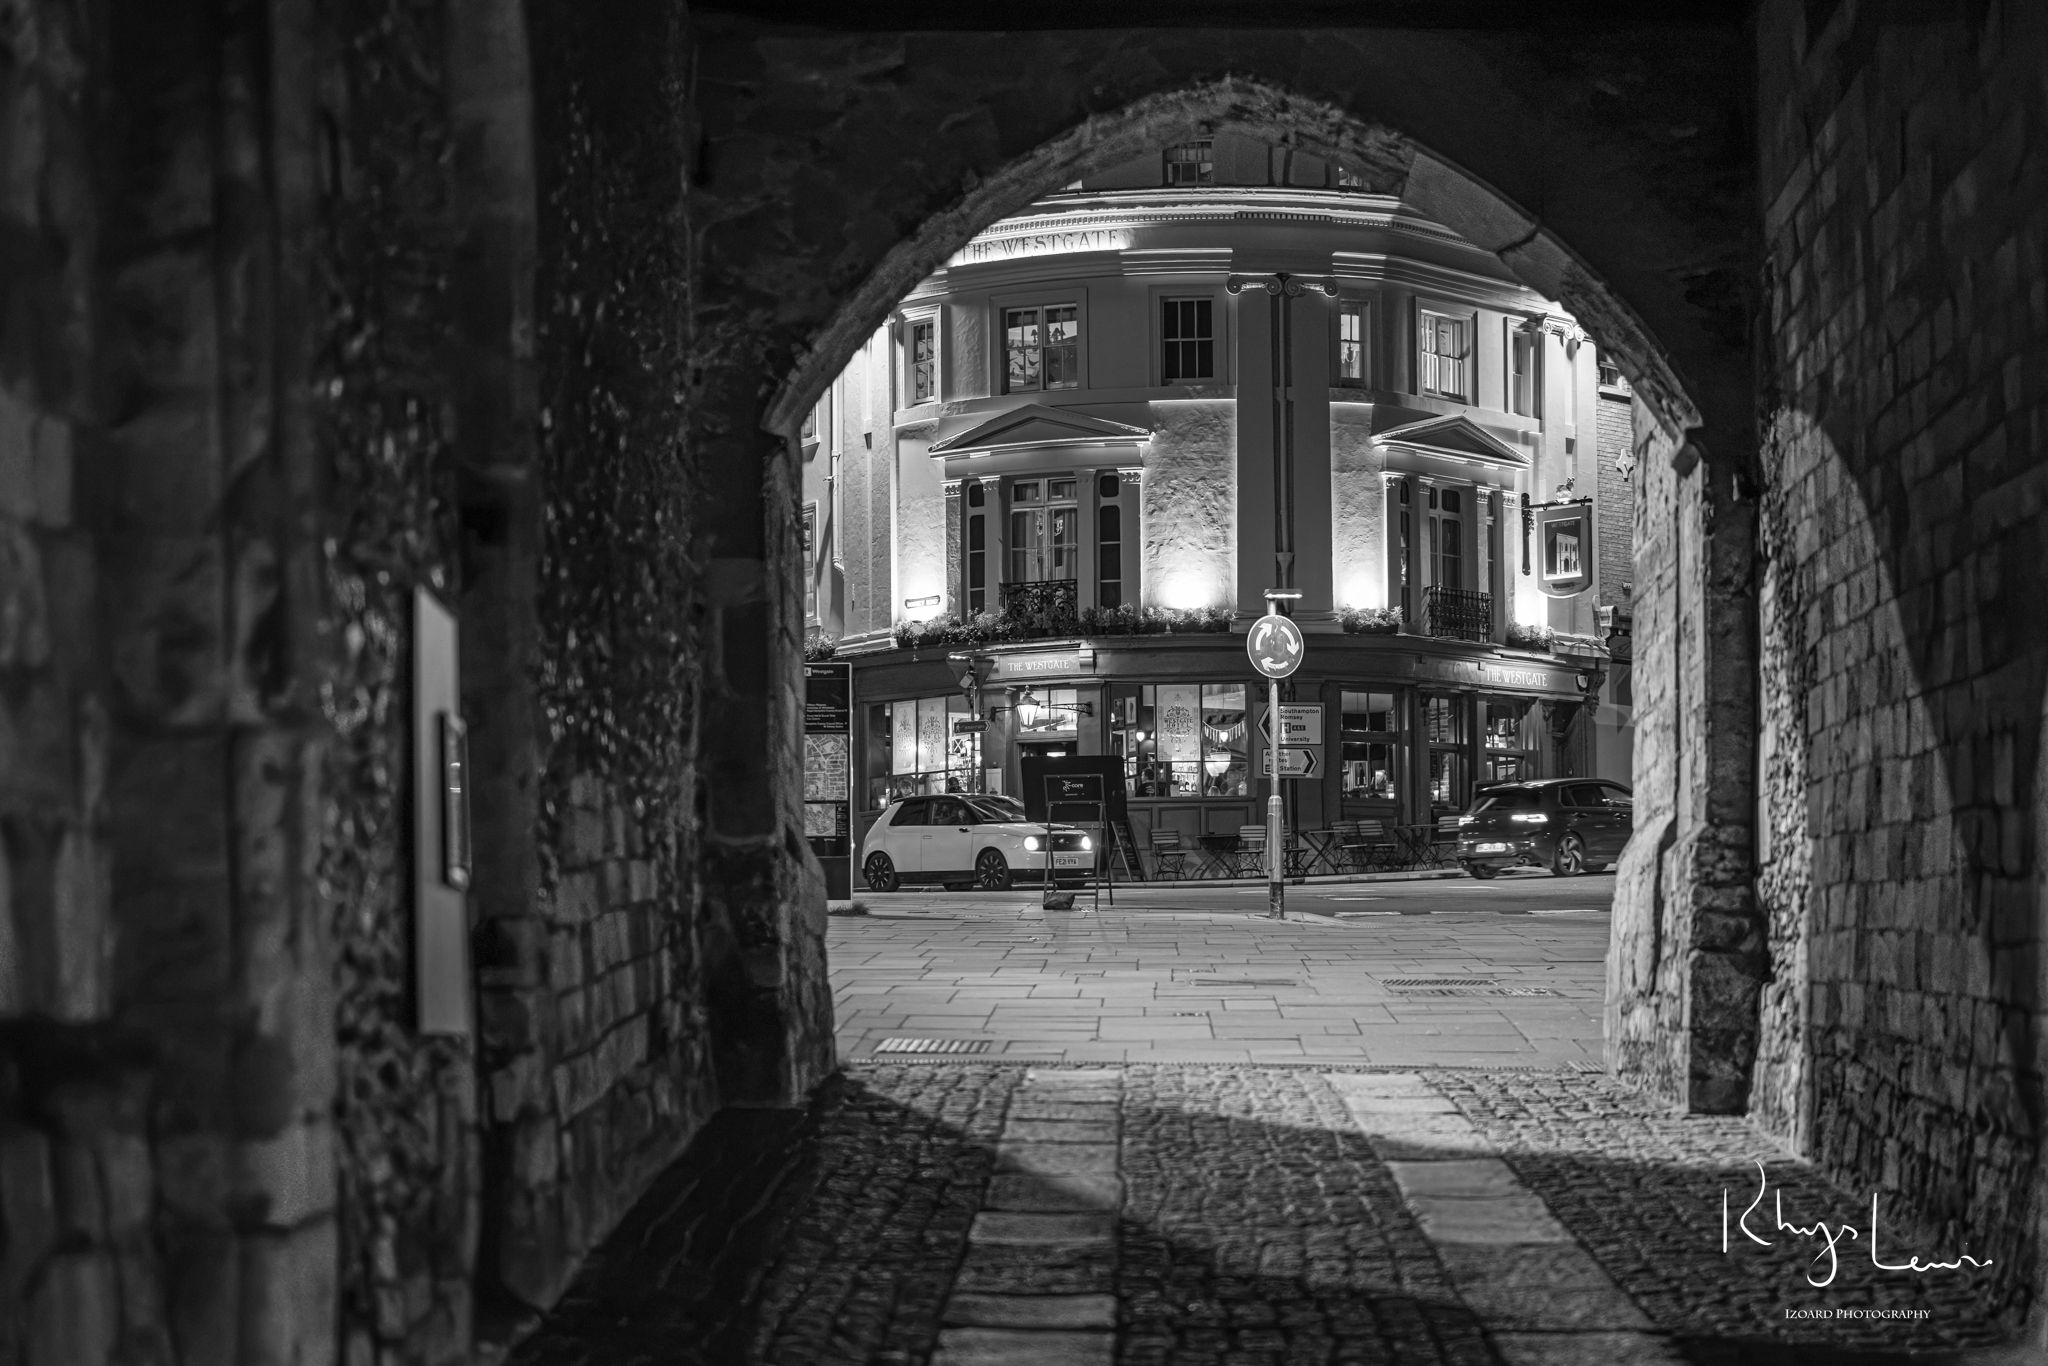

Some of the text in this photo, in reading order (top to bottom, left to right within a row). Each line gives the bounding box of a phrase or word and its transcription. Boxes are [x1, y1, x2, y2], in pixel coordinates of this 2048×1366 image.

[961, 229, 1119, 262] THE WESTGATE
[1007, 660, 1069, 672] THE WESTGATE
[1486, 667, 1548, 687] THE WESTGATE
